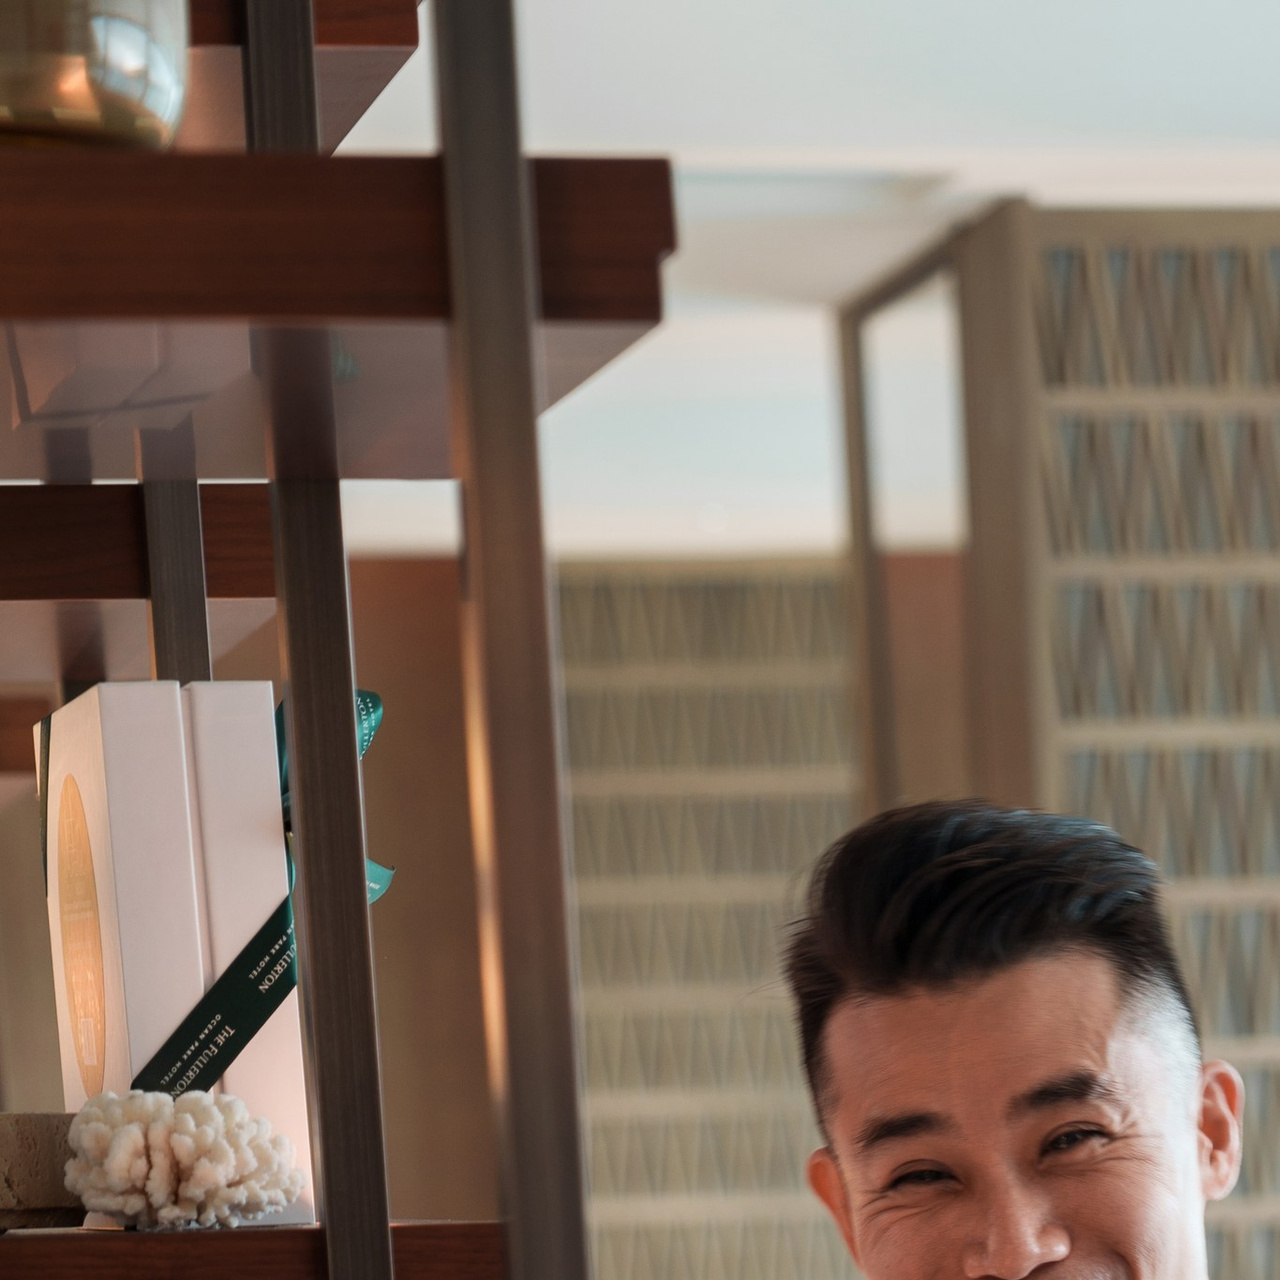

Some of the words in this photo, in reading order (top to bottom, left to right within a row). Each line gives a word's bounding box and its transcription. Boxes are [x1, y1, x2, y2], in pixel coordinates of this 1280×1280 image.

[270, 935, 287, 955] PARK
[248, 955, 270, 979] HOTEL
[199, 1014, 221, 1040] OCEAN
[213, 1025, 236, 1047] THE
[182, 1041, 199, 1060] PARK
[160, 1061, 182, 1085] HOTEL
[170, 1044, 219, 1098] FULLERTON
